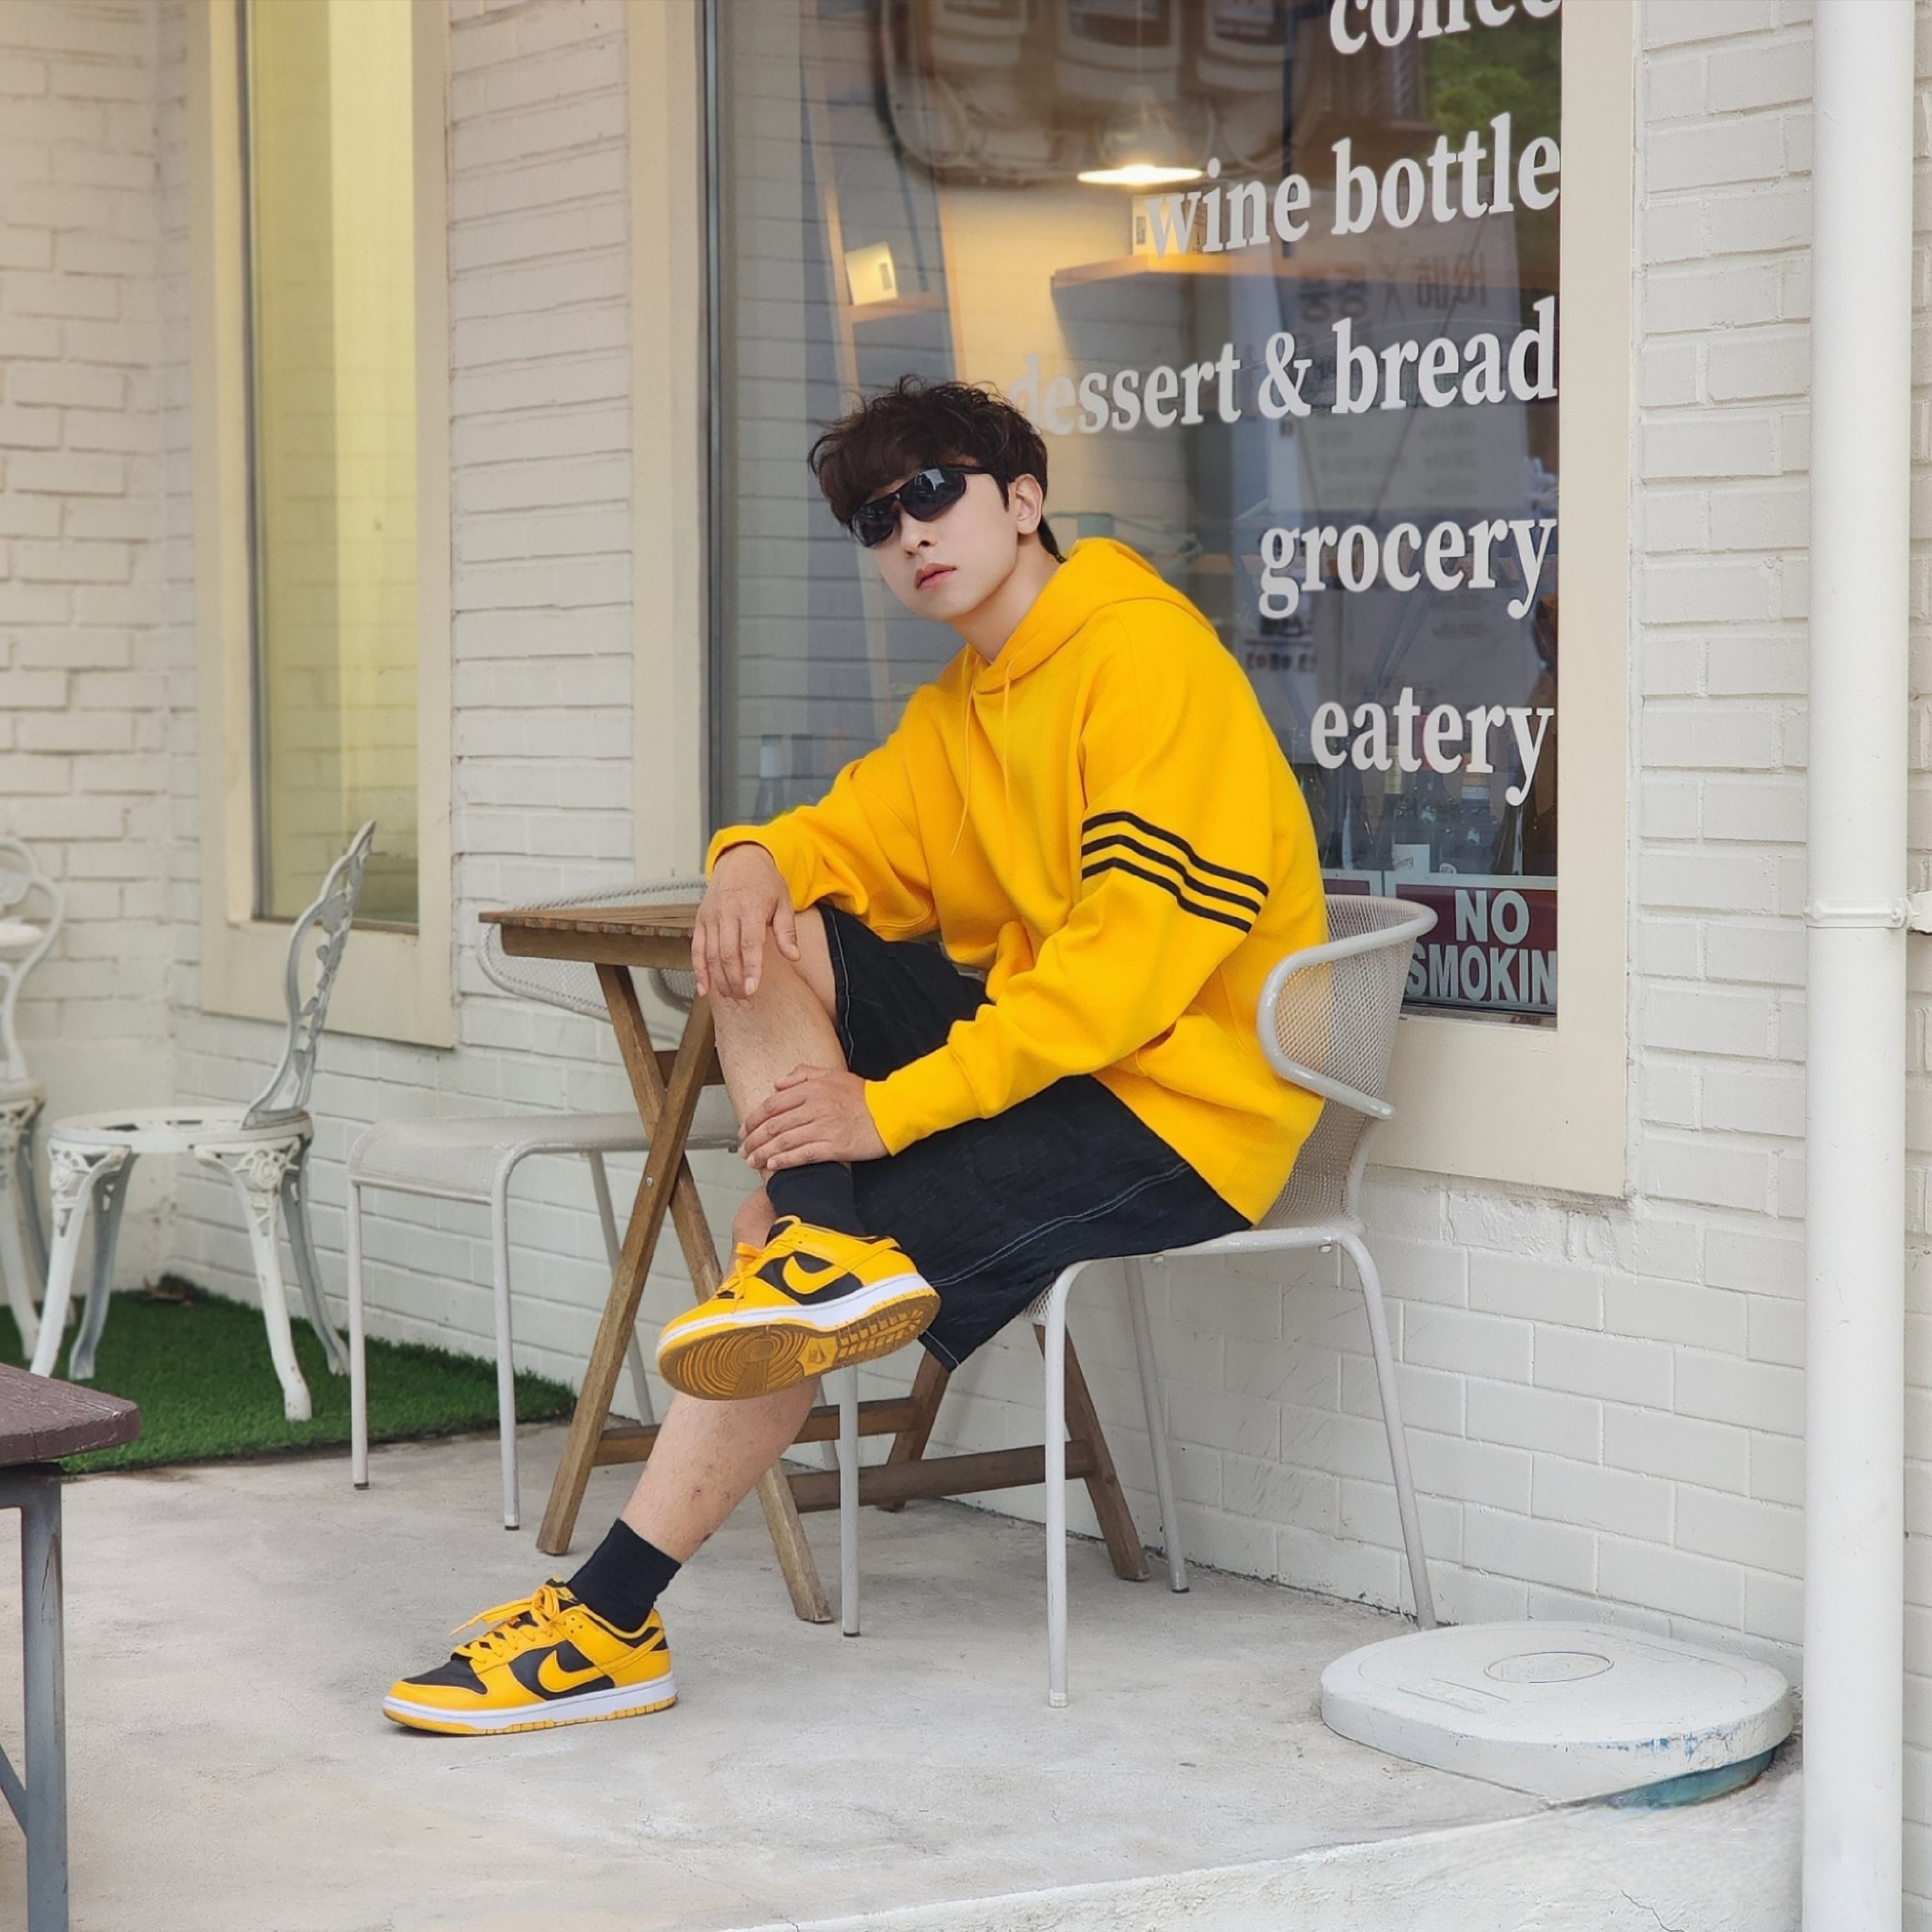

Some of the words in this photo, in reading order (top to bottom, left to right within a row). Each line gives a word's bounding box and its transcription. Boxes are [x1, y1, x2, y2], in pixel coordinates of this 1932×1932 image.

[1144, 158, 1310, 259] wine
[1331, 112, 1560, 235] bottle
[1007, 343, 1242, 436] dessert
[1258, 332, 1312, 419] &
[1331, 296, 1558, 414] bread
[1259, 518, 1557, 619] grocery
[1311, 687, 1554, 806] eatery
[1454, 889, 1530, 945] NO
